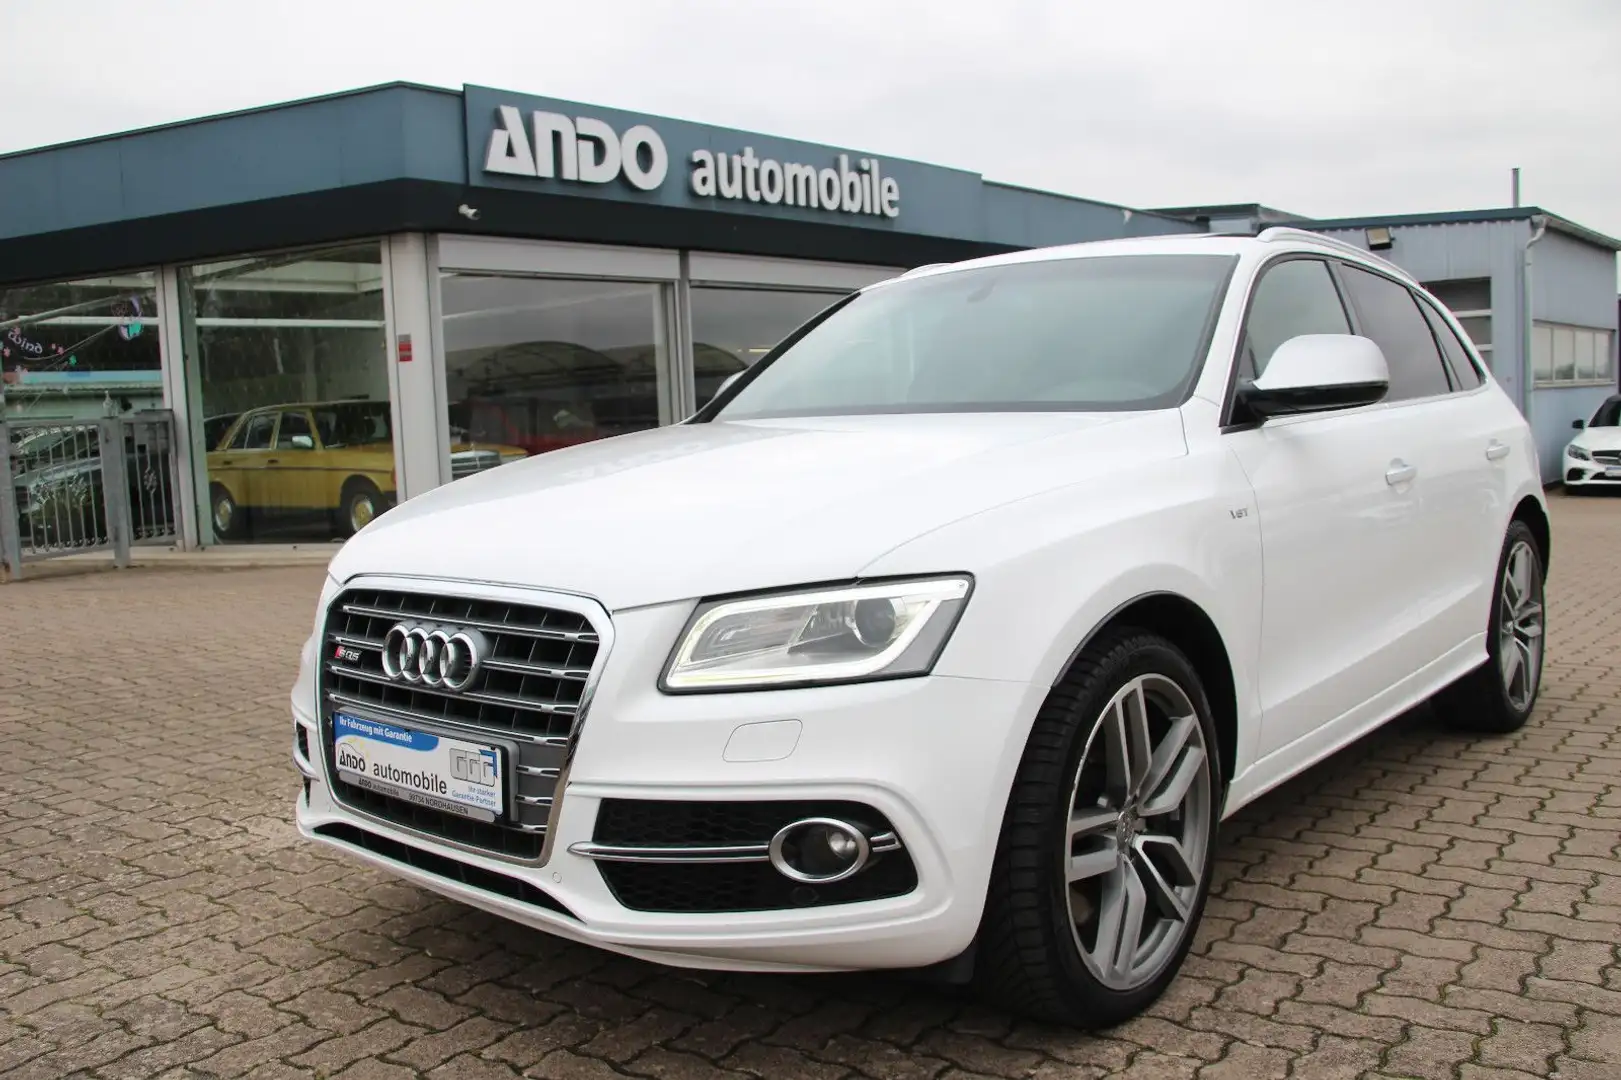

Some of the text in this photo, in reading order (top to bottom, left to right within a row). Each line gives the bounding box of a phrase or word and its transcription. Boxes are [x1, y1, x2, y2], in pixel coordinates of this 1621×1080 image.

[484, 105, 900, 218] ANDO automobile
[339, 716, 413, 743] Ihr Fahrzeug mit Garantie
[373, 763, 447, 795] automobile
[425, 796, 469, 815] NORDHAUSEN
